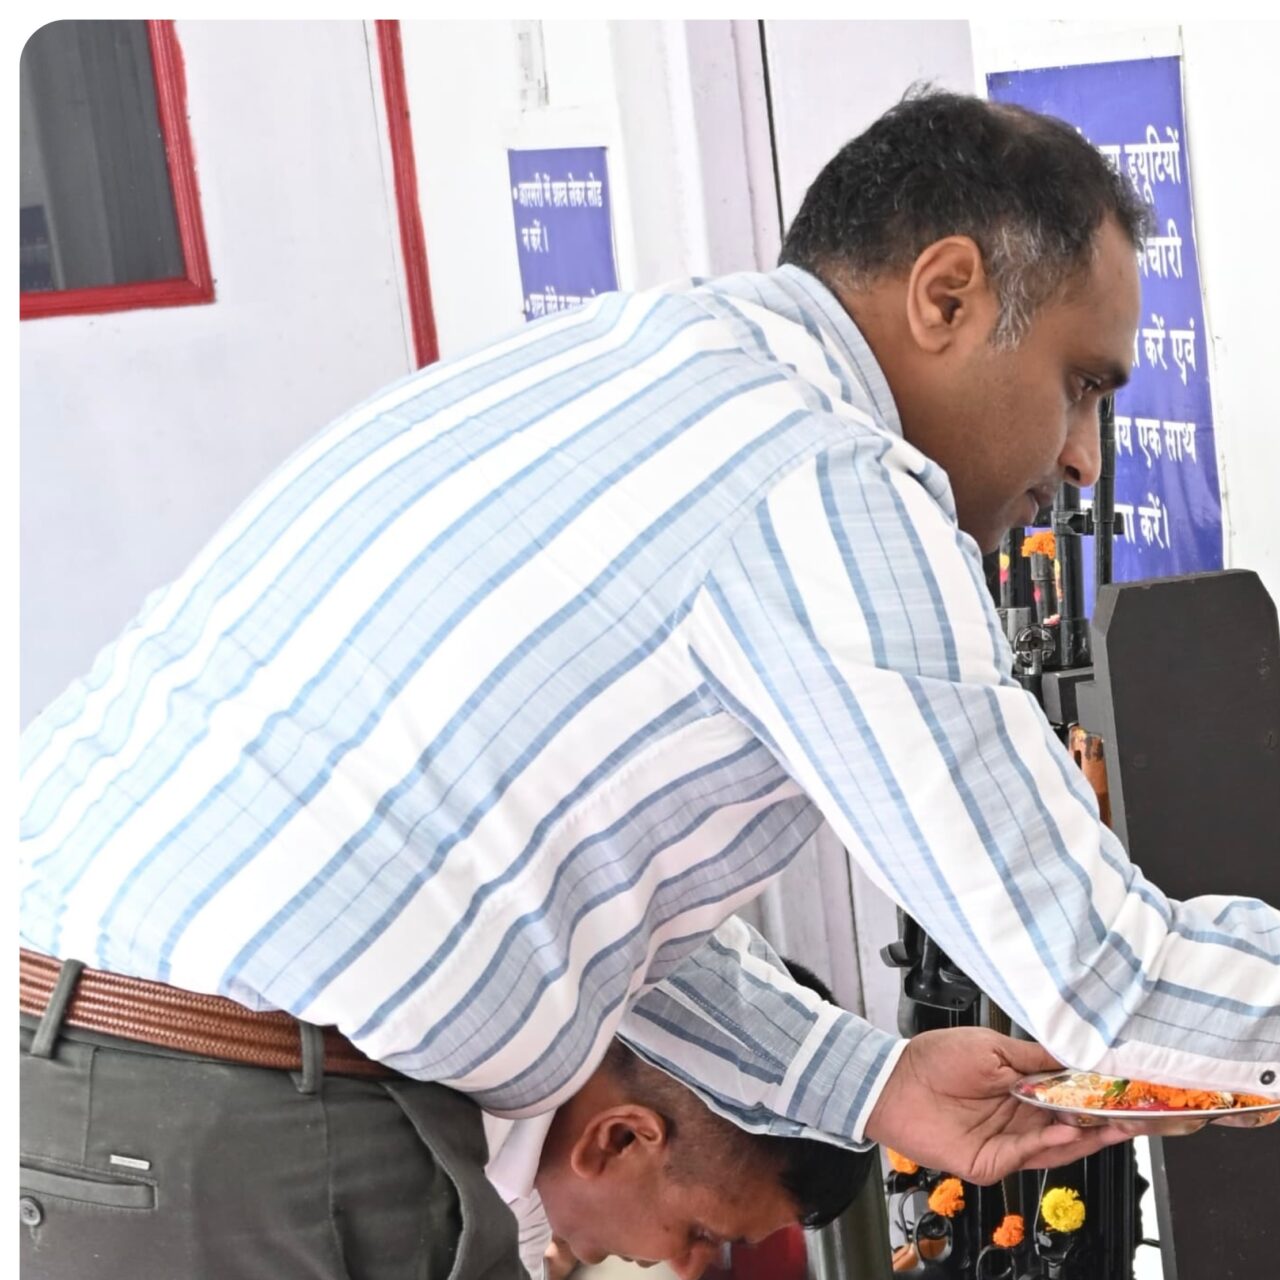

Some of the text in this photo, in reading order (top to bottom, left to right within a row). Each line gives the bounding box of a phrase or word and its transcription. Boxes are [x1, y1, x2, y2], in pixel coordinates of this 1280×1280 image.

[1124, 125, 1181, 204] ड्यूटियों
[1143, 313, 1168, 370] करें
[1170, 318, 1197, 386] एवं
[1135, 417, 1162, 469] एक
[1164, 420, 1197, 464] साथ
